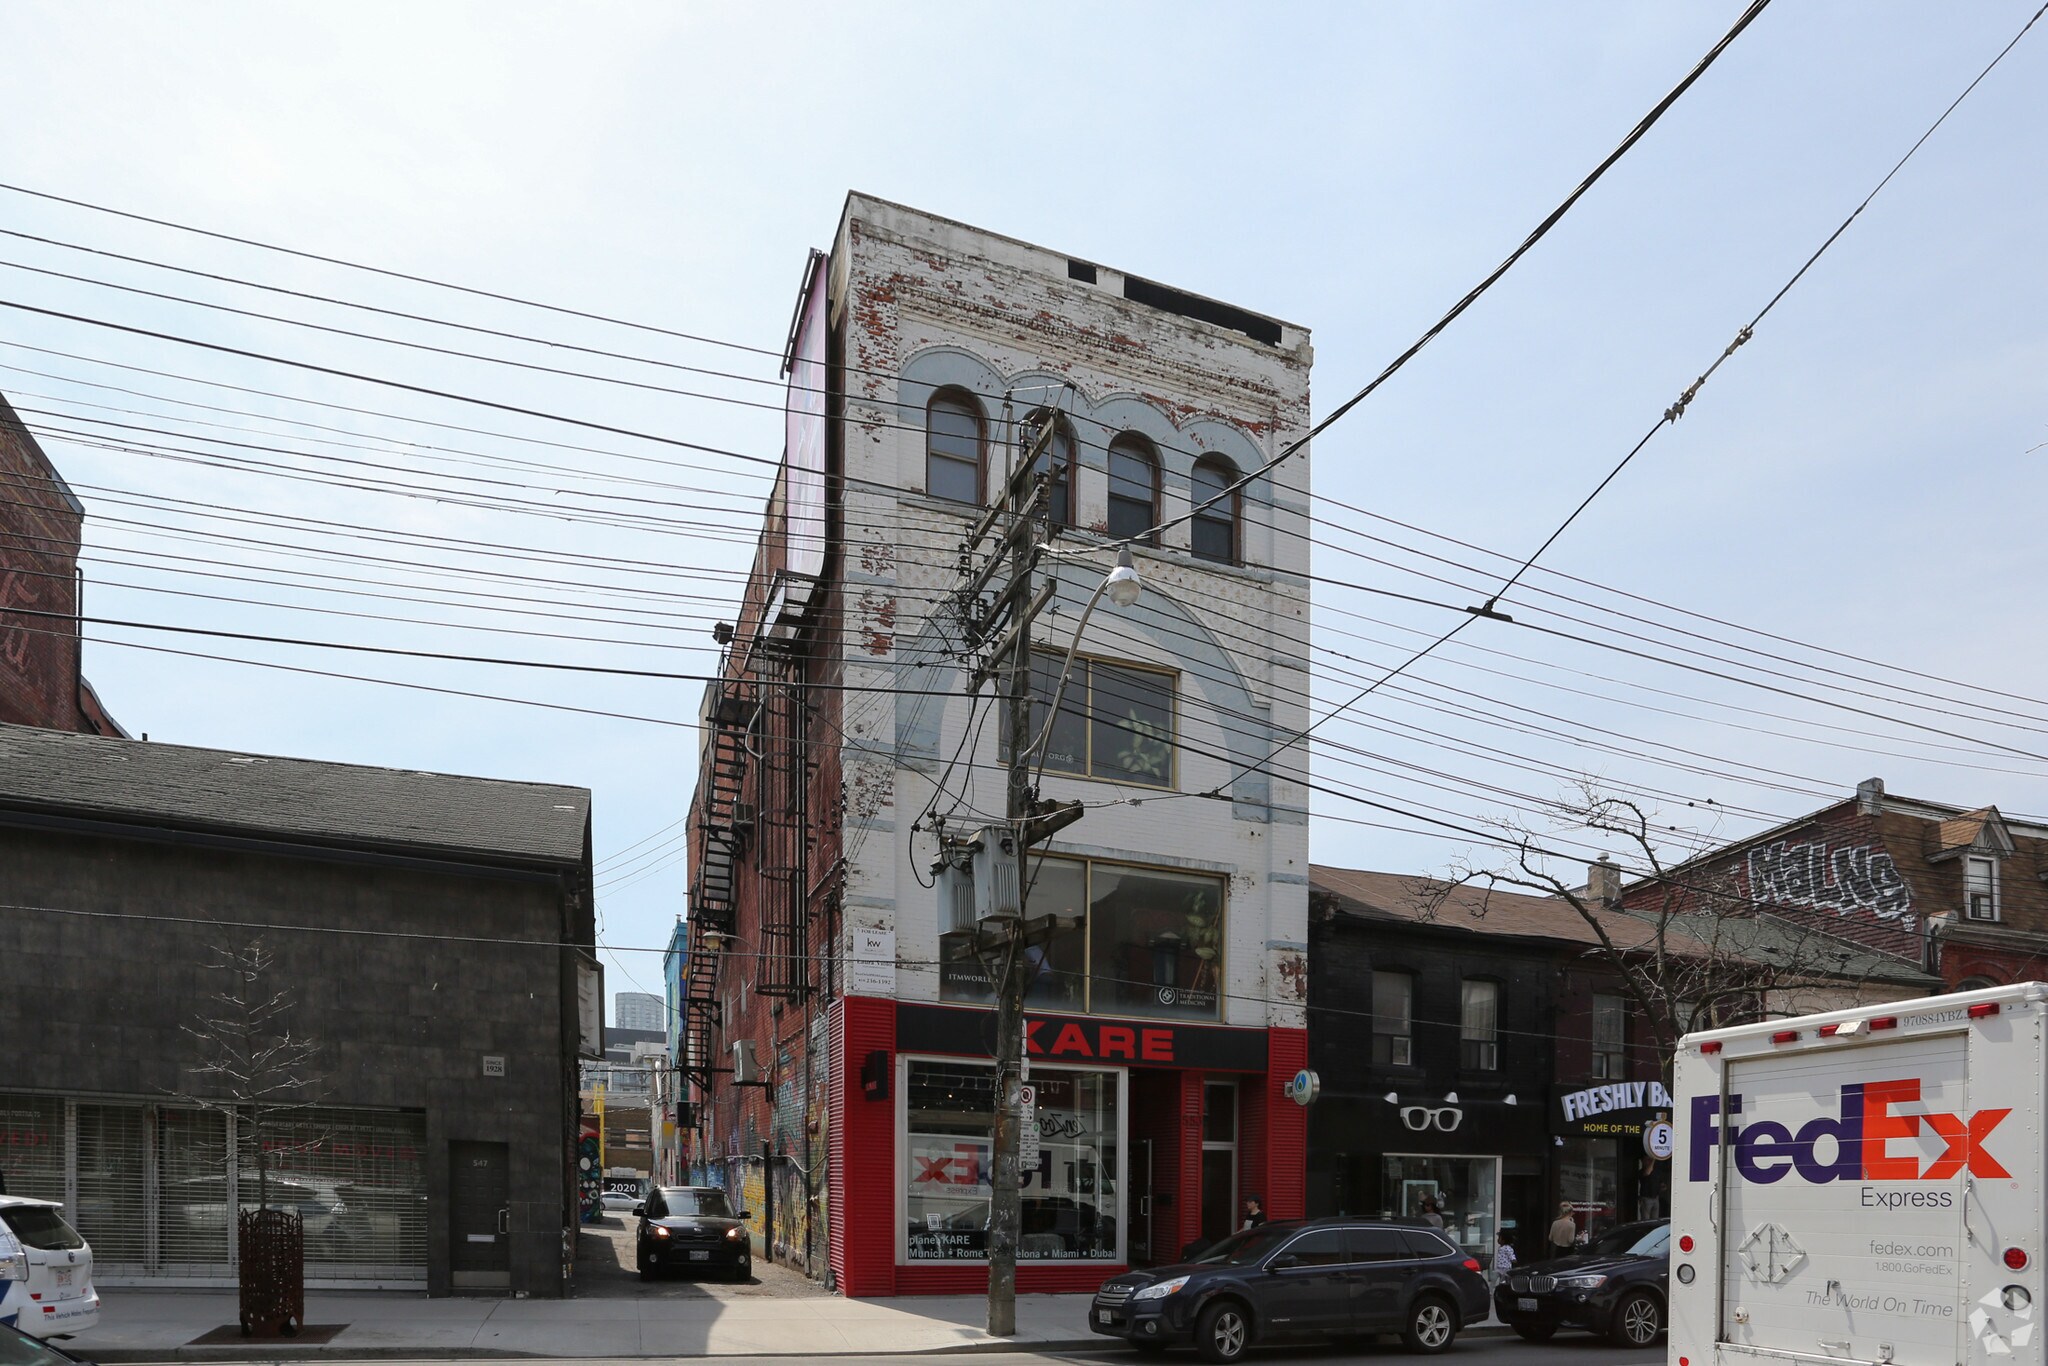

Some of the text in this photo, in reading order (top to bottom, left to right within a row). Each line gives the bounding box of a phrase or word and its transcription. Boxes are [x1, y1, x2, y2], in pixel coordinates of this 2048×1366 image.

[867, 937, 881, 947] kw
[1026, 1021, 1173, 1062] KARE
[1560, 1081, 1648, 1122] FRESHLY
[1583, 1123, 1640, 1133] HOME OF THE
[1690, 1078, 2013, 1184] FedEx
[1658, 1129, 1667, 1144] 5
[610, 1183, 636, 1193] 2020
[1861, 1187, 1953, 1211] Express
[942, 1235, 970, 1245] KARE
[908, 1248, 945, 1258] Munich
[956, 1249, 984, 1258] Rome
[1052, 1249, 1080, 1258] Miami
[1090, 1247, 1116, 1258] Dubai
[1869, 1240, 1954, 1257] fedex.com
[1875, 1262, 1953, 1275] 1.800.GoFedEx
[1806, 1290, 1953, 1316] The World On Time
